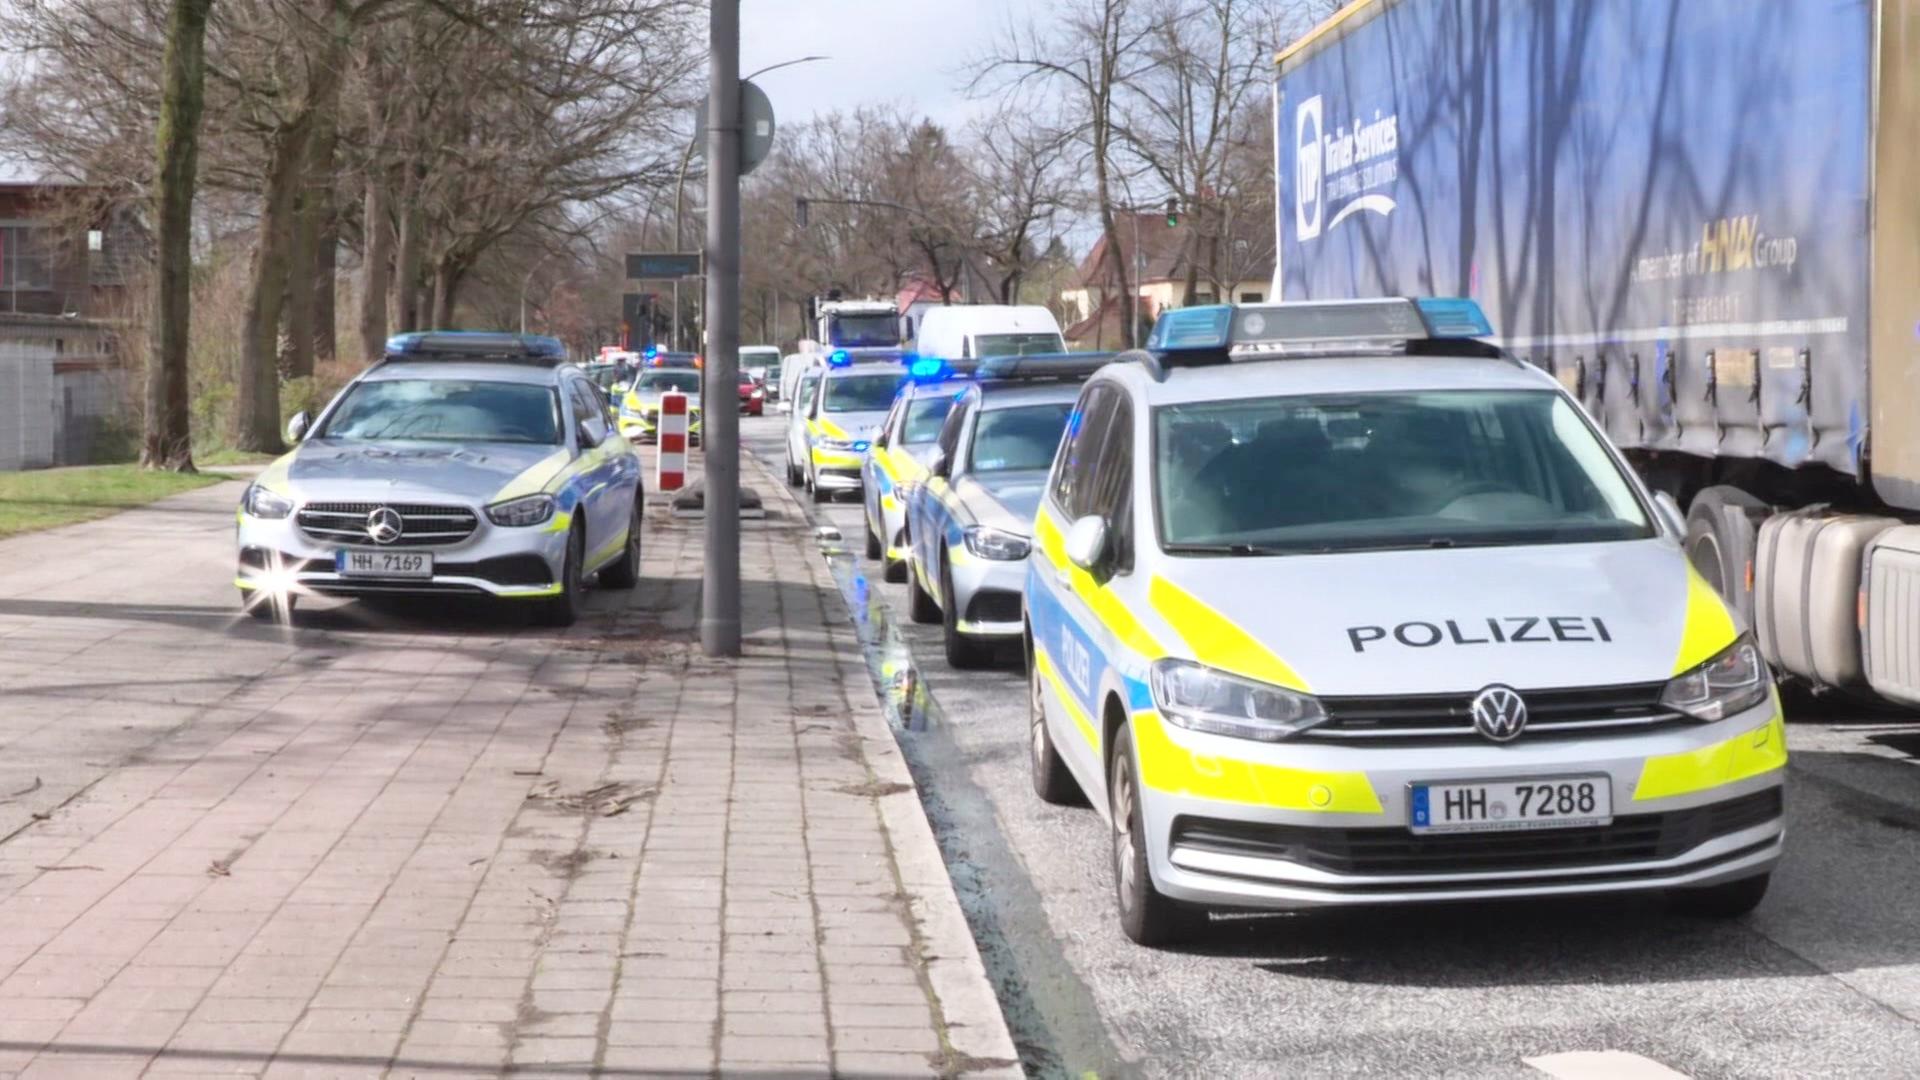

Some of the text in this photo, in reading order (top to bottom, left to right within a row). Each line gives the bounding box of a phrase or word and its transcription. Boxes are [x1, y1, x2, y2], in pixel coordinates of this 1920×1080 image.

[1324, 108, 1397, 177] Trailer Services
[1754, 233, 1797, 274] Group
[352, 554, 423, 571] HH 7169
[1346, 616, 1613, 653] POLIZEI
[1444, 788, 1488, 821] HH
[1515, 783, 1595, 817] 7288
